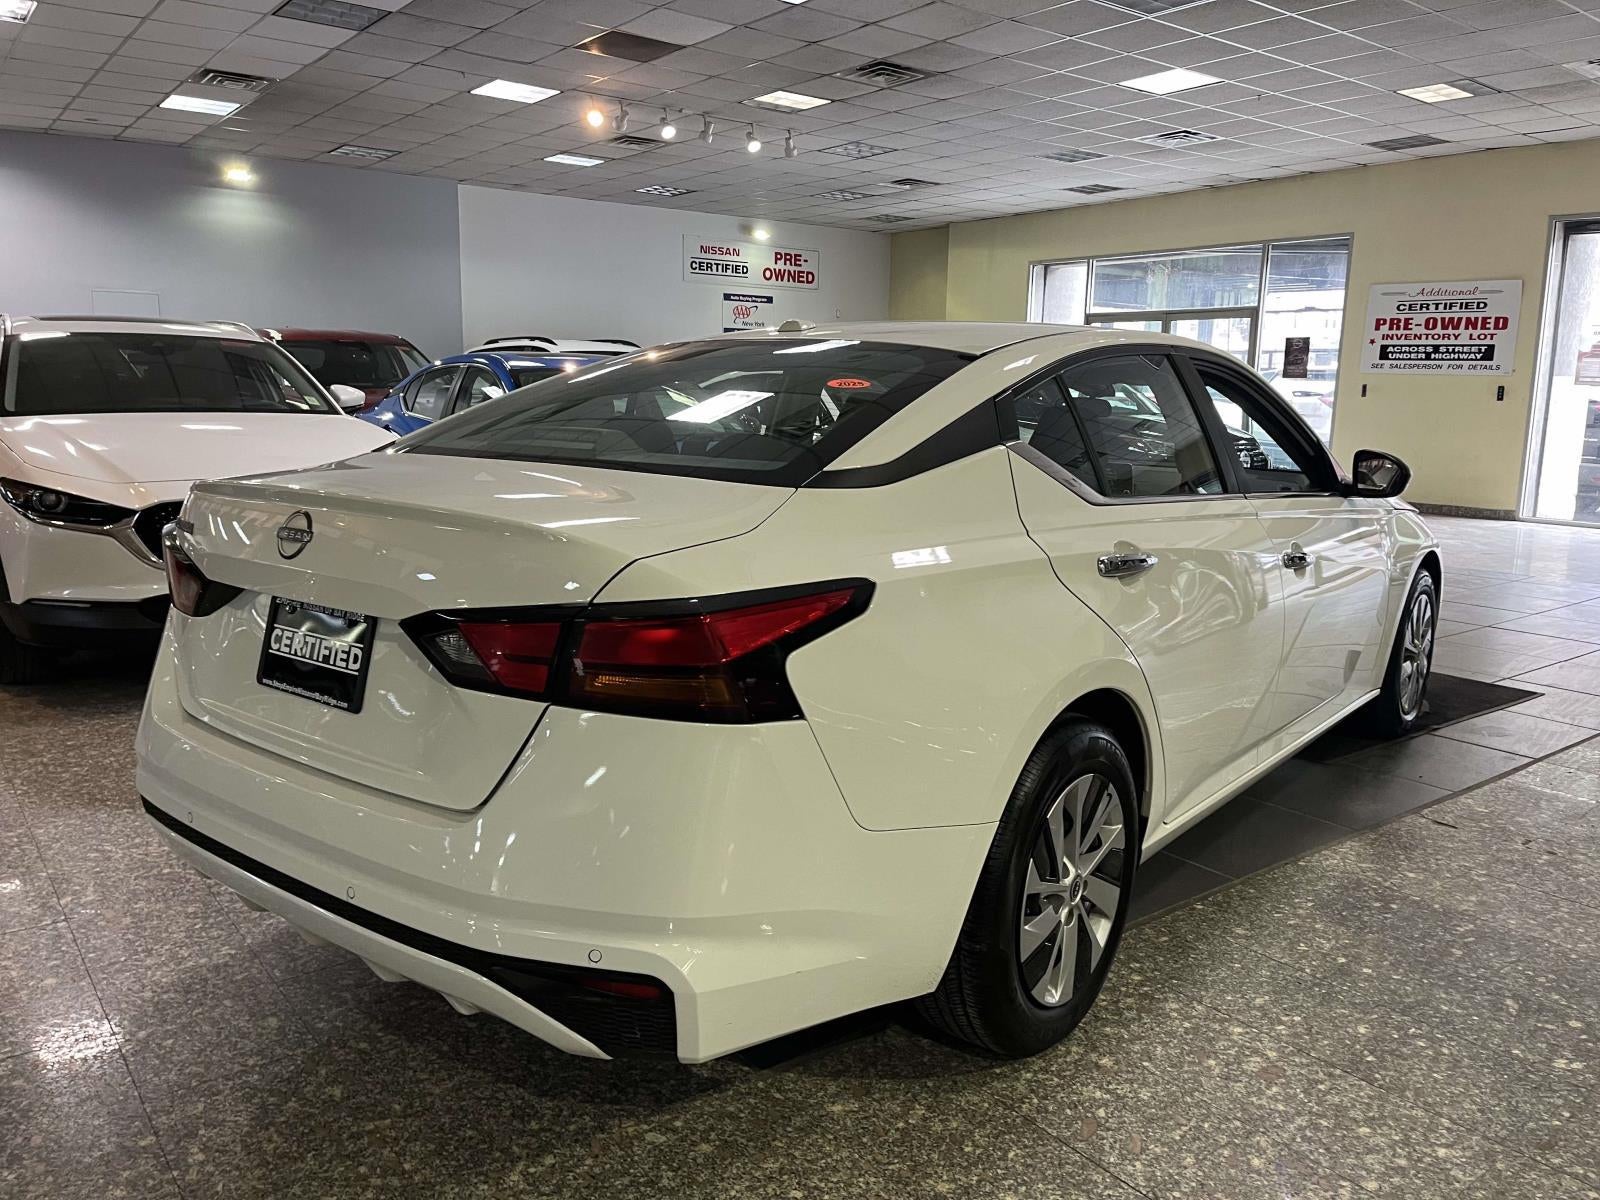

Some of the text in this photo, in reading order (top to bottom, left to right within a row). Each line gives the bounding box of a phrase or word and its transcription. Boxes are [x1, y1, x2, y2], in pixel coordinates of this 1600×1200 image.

[700, 245, 740, 257] NISSAN
[774, 251, 808, 267] PRE-
[690, 260, 749, 275] CERTIFIED
[762, 267, 815, 285] OWNED
[1408, 286, 1479, 298] Additional
[1396, 301, 1488, 312] CERTIFIED
[1374, 316, 1510, 331] PRE-OWNED
[1381, 333, 1498, 341] INVENTORY LOT
[270, 628, 363, 671] CERTIFIED
